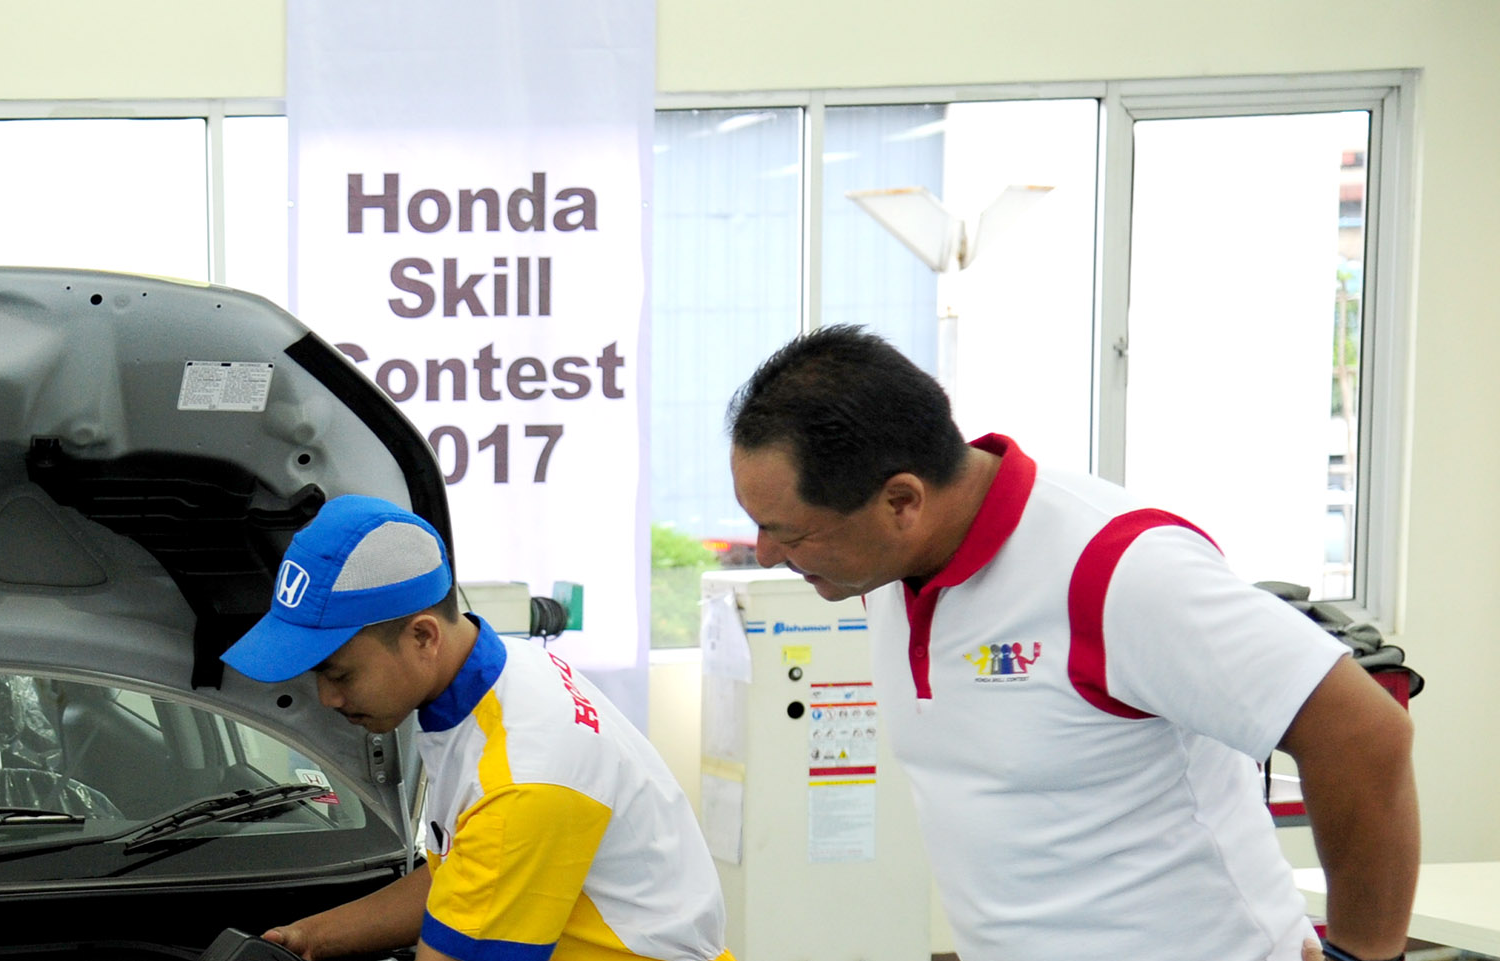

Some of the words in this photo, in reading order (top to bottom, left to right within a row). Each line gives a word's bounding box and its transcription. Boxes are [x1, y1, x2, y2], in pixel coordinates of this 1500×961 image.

[347, 172, 598, 233] Honda
[387, 256, 552, 318] Skill
[333, 341, 626, 403] ontest
[428, 424, 564, 485] 017
[773, 621, 832, 636] Bishamon
